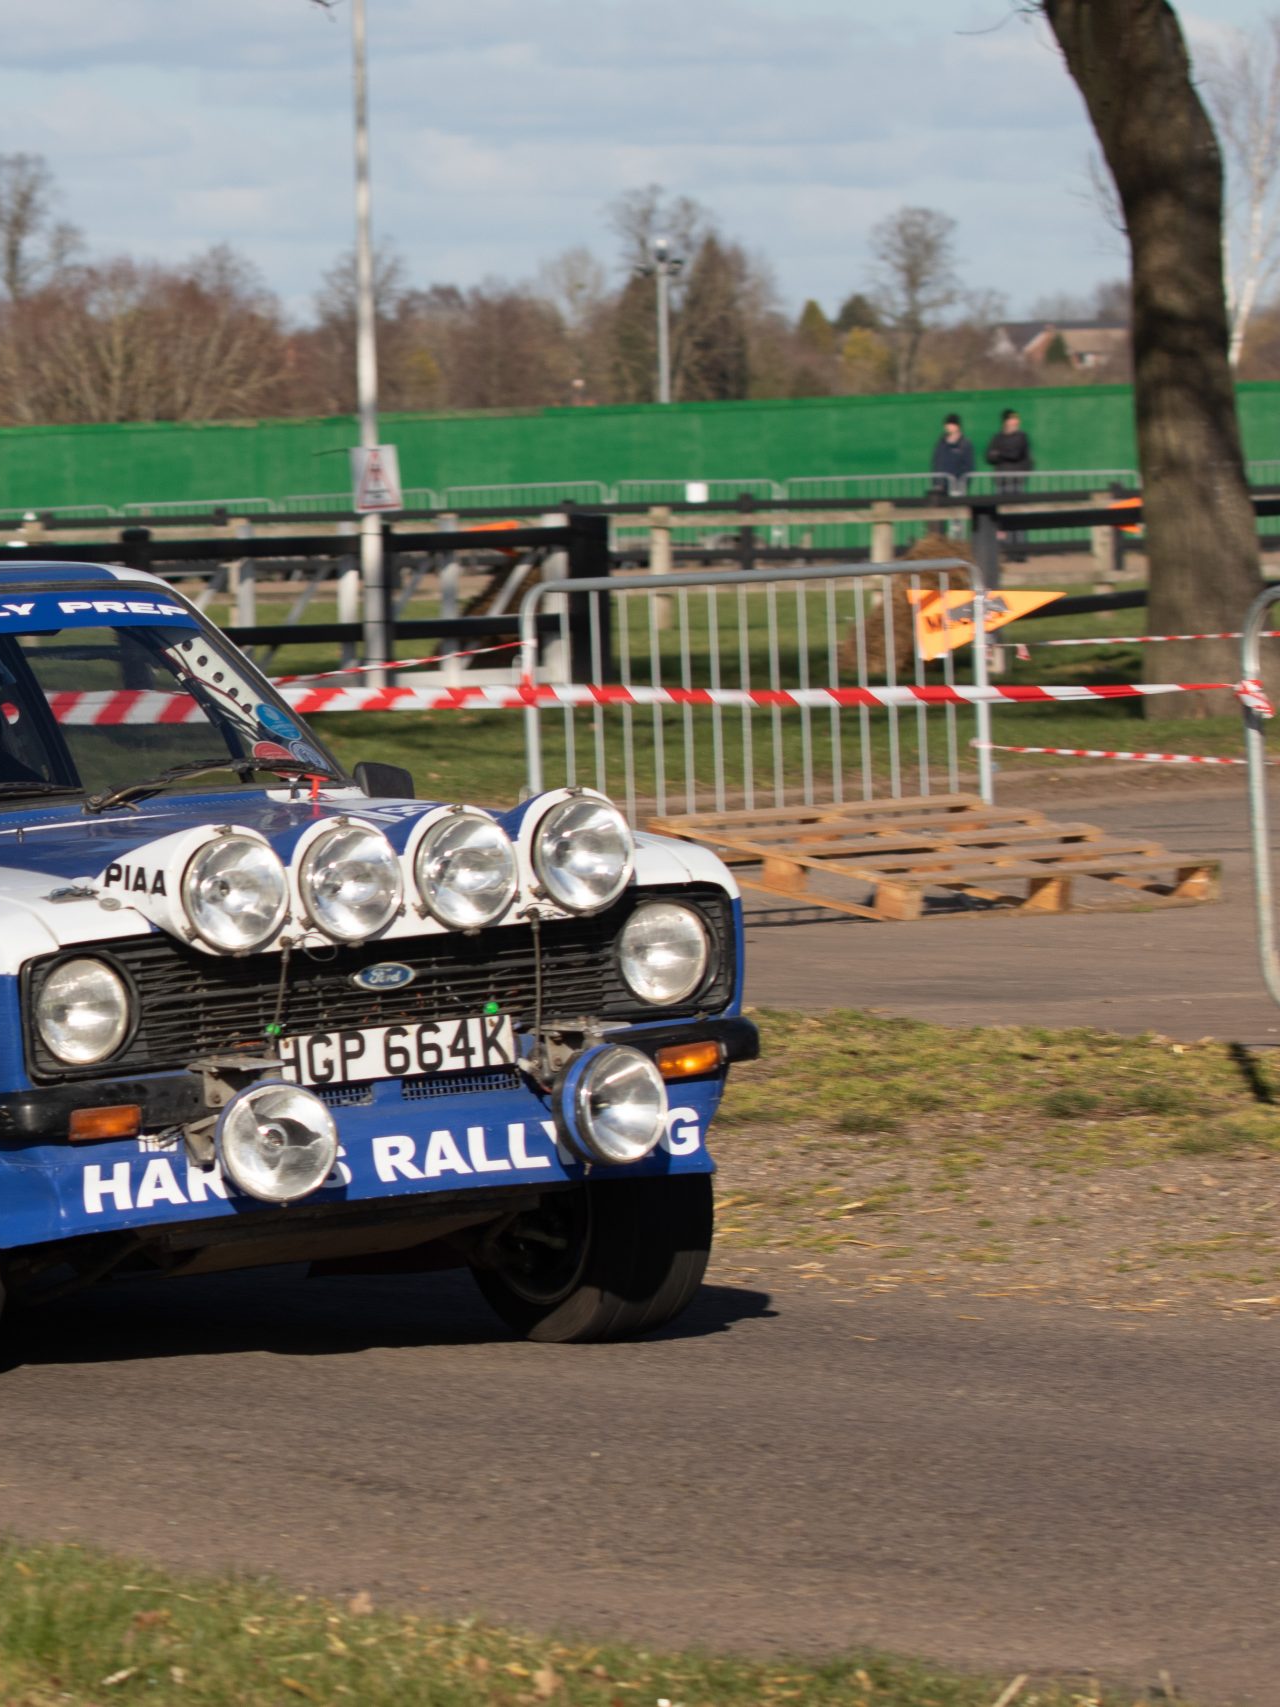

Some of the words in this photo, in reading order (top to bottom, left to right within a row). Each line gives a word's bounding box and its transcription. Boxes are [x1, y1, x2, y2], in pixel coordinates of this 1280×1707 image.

[58, 601, 188, 616] PREP
[103, 862, 167, 897] PIAA
[367, 967, 402, 984] Ford
[383, 1014, 512, 1075] 664K
